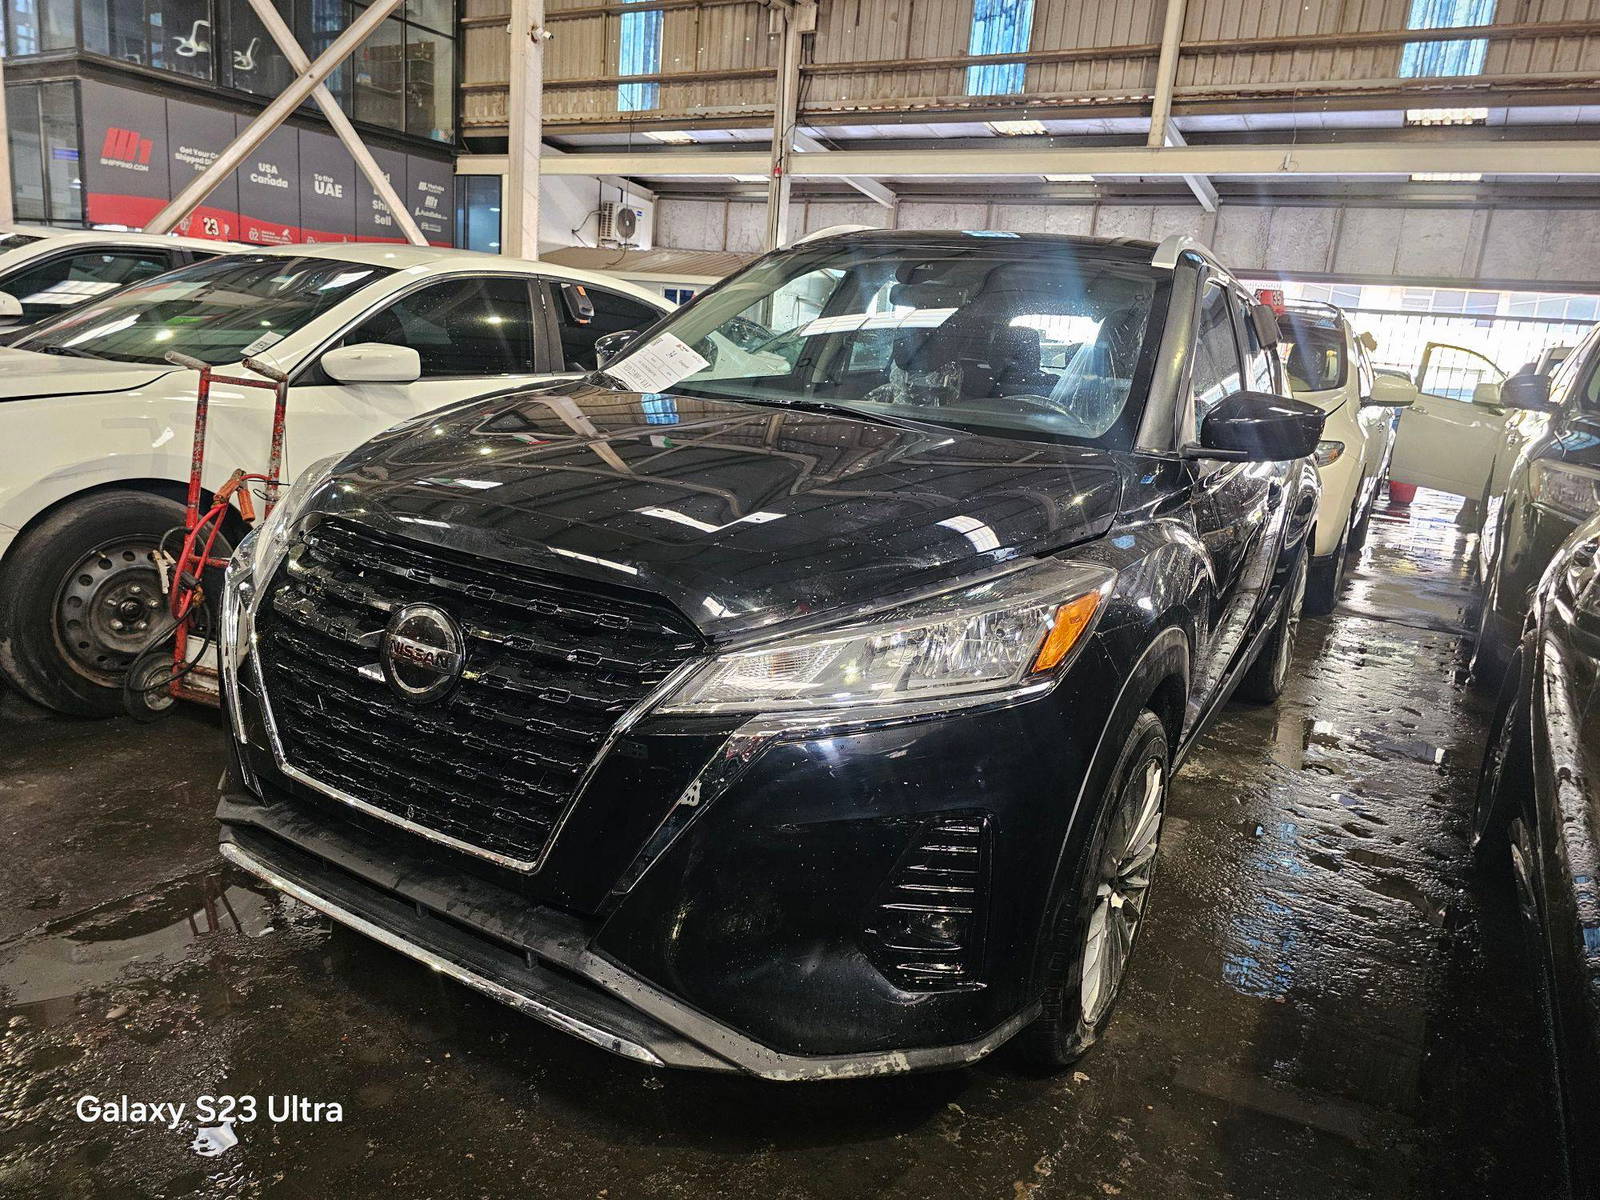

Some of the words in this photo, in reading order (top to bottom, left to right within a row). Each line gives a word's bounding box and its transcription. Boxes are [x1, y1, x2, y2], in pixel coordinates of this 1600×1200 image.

[175, 152, 204, 164] Shipped
[179, 146, 193, 155] Get
[194, 148, 210, 158] Your
[258, 163, 278, 175] USA
[250, 173, 288, 188] Canada
[314, 181, 343, 198] UAE
[203, 216, 219, 236] 23
[374, 214, 392, 226] Sell
[390, 639, 449, 668] NISSAN
